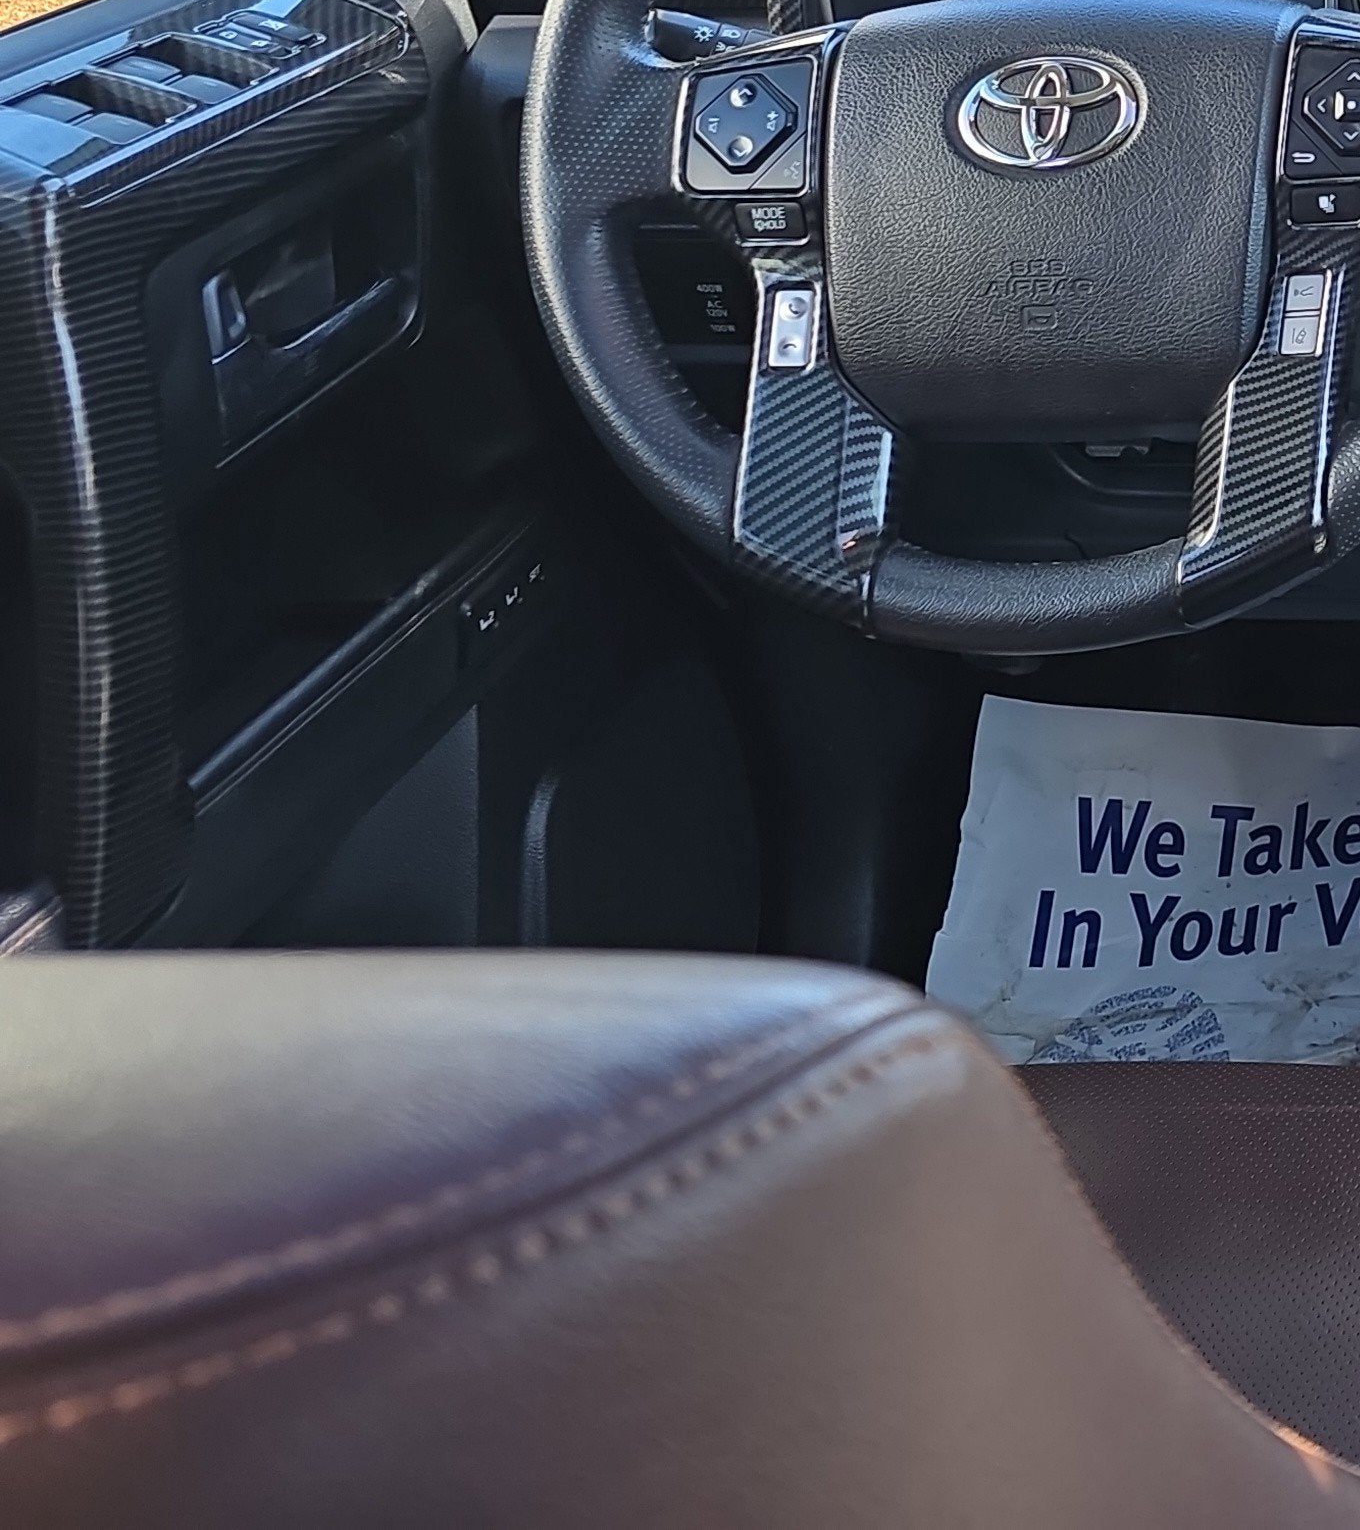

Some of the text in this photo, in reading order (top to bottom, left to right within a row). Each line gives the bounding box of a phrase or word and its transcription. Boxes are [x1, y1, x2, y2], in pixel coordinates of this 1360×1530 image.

[751, 207, 786, 219] MODE
[1077, 795, 1185, 878] We
[1028, 889, 1101, 968] In
[1129, 892, 1296, 967] Your
